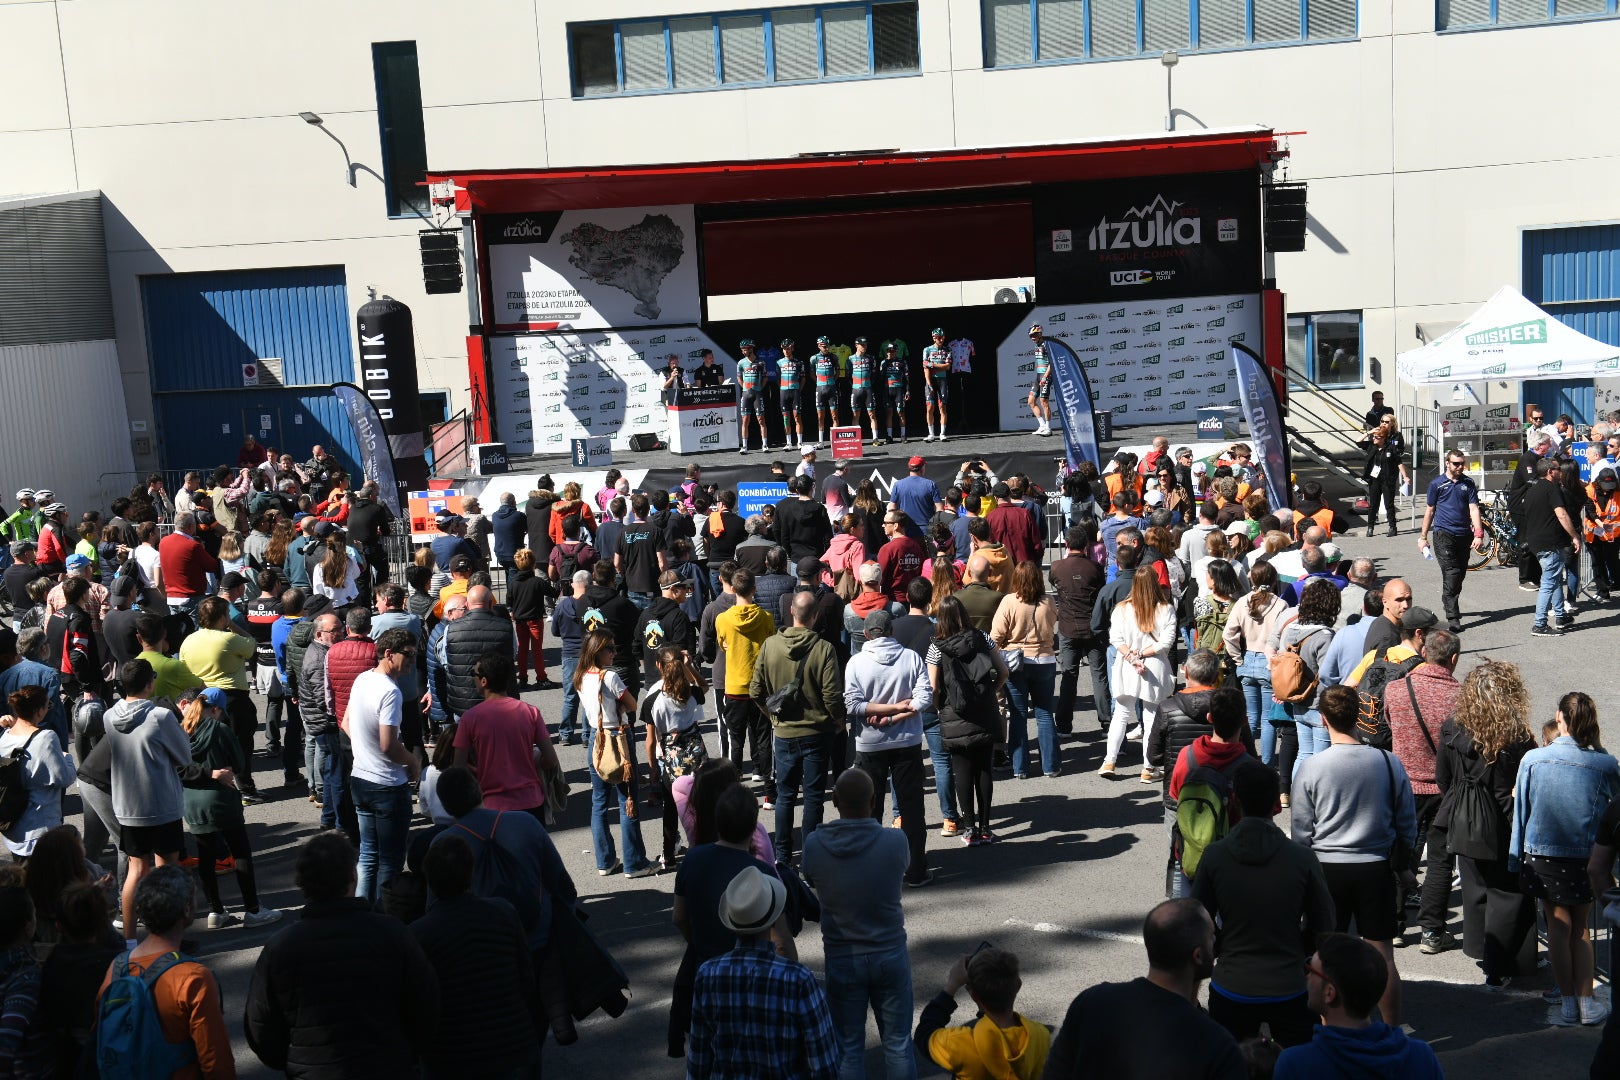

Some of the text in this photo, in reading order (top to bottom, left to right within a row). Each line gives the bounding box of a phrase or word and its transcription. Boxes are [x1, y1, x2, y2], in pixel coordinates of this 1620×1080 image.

[1113, 272, 1137, 284] UCI
[506, 291, 531, 299] ITZULIA
[507, 299, 592, 310] ETAPAS DE LA ITZULIA 2023
[1467, 324, 1542, 345] FINISHER
[738, 488, 788, 497] GONBIDATUA
[248, 609, 279, 617] FIDUCIAL
